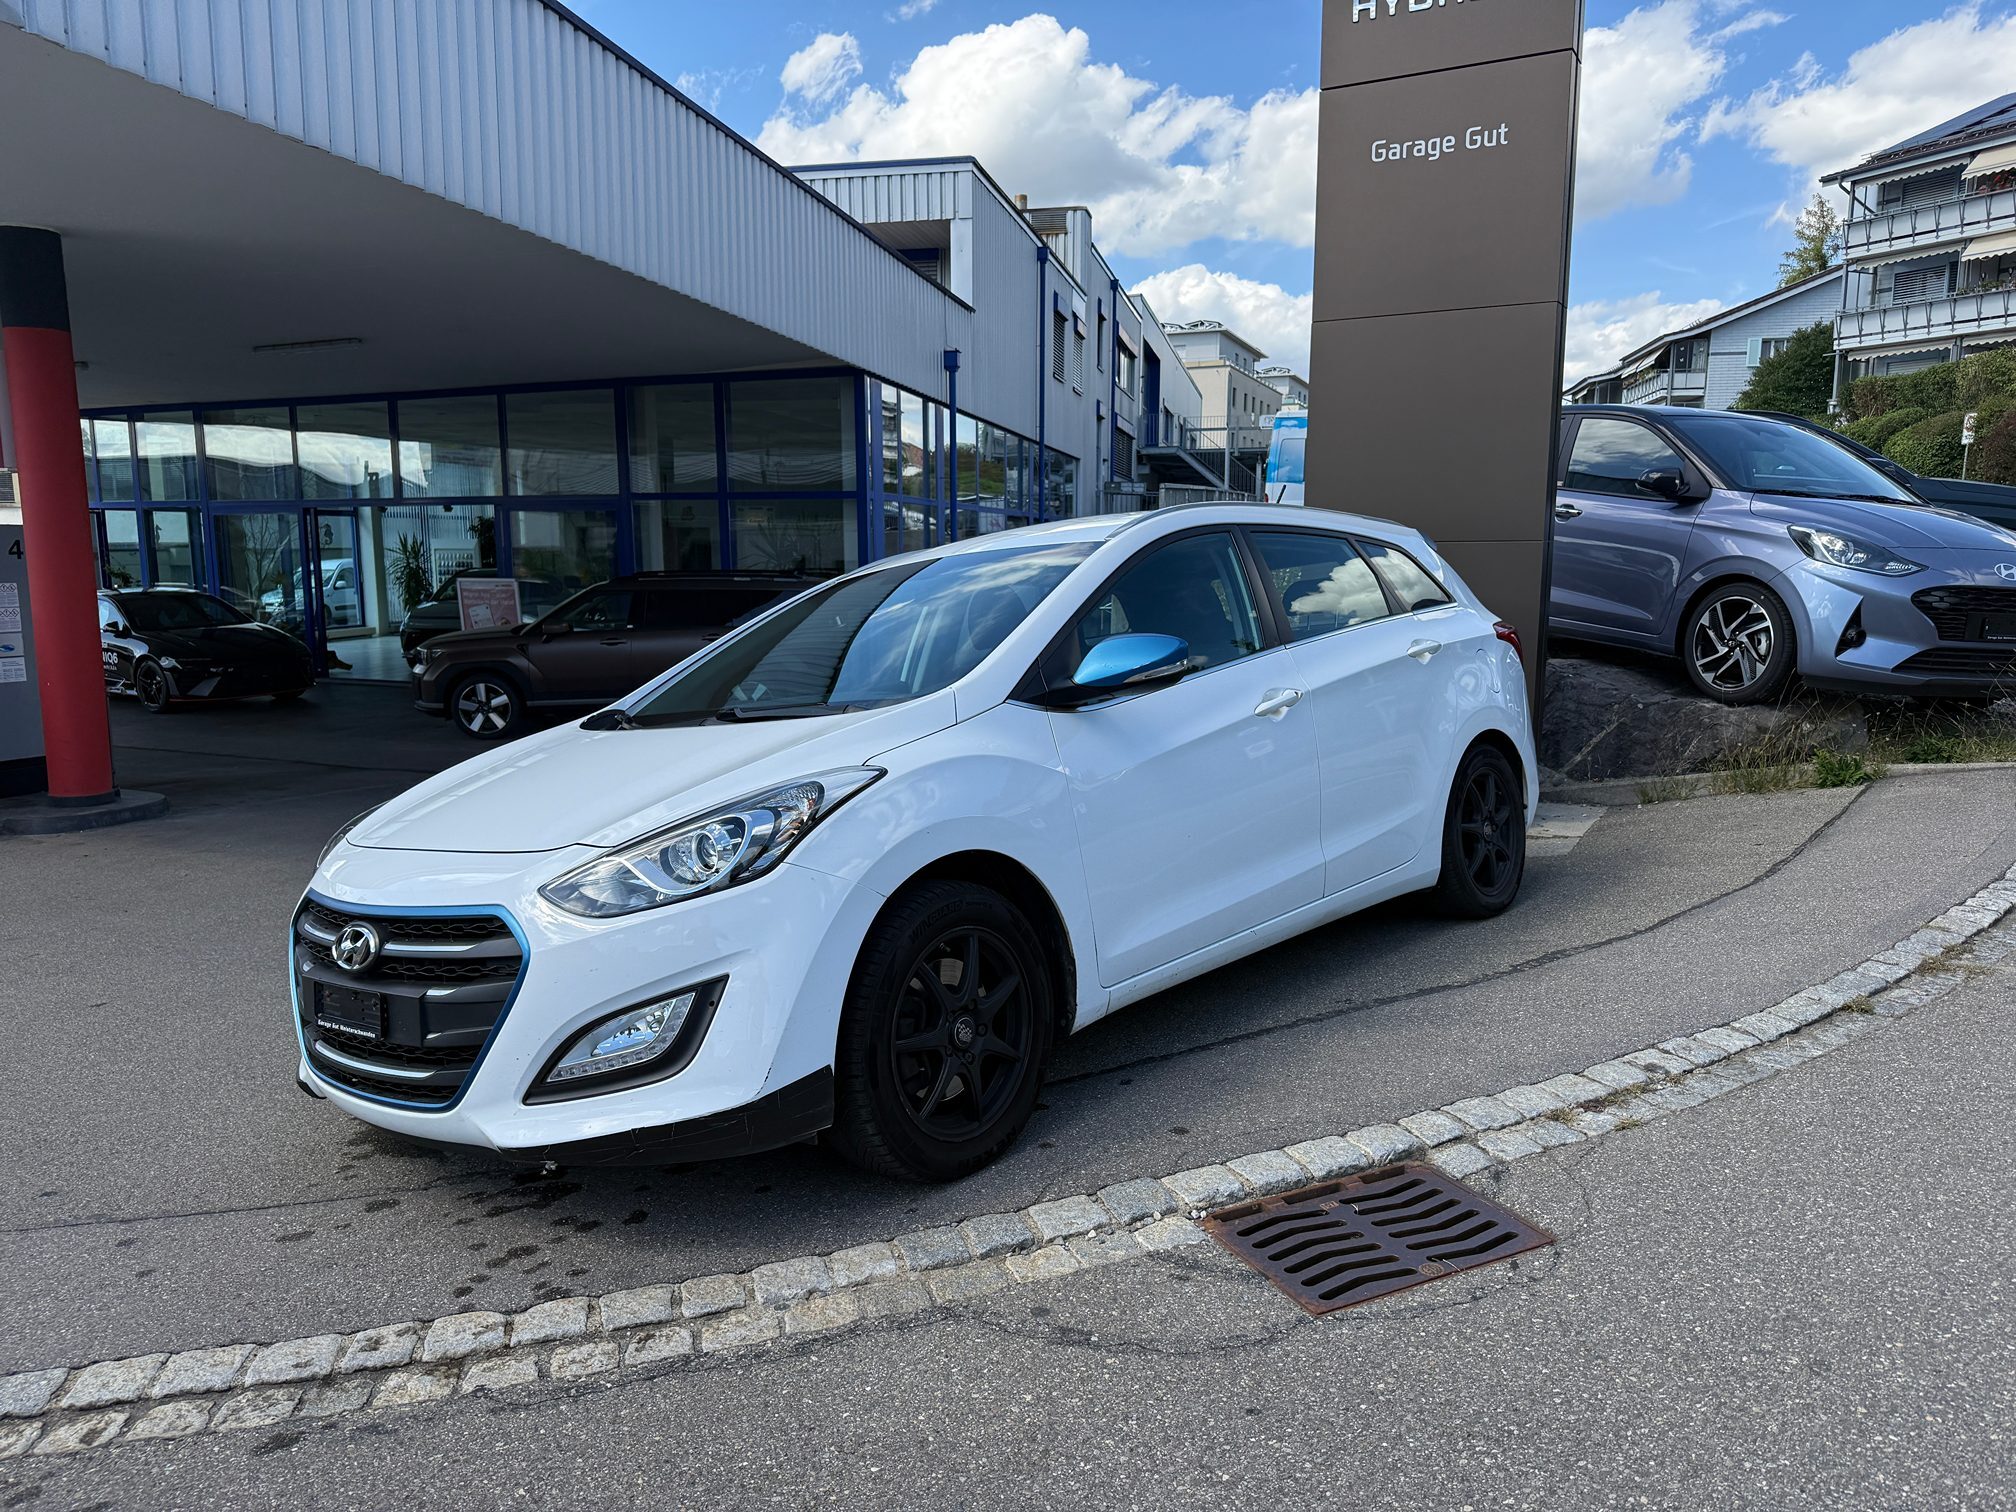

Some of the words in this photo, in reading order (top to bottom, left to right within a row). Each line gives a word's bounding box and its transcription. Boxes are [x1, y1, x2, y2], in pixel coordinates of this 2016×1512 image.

[1371, 135, 1455, 162] Garage
[1465, 123, 1509, 149] Gut
[8, 540, 23, 559] 4
[317, 1019, 331, 1028] Garage
[332, 1022, 340, 1030] Gut
